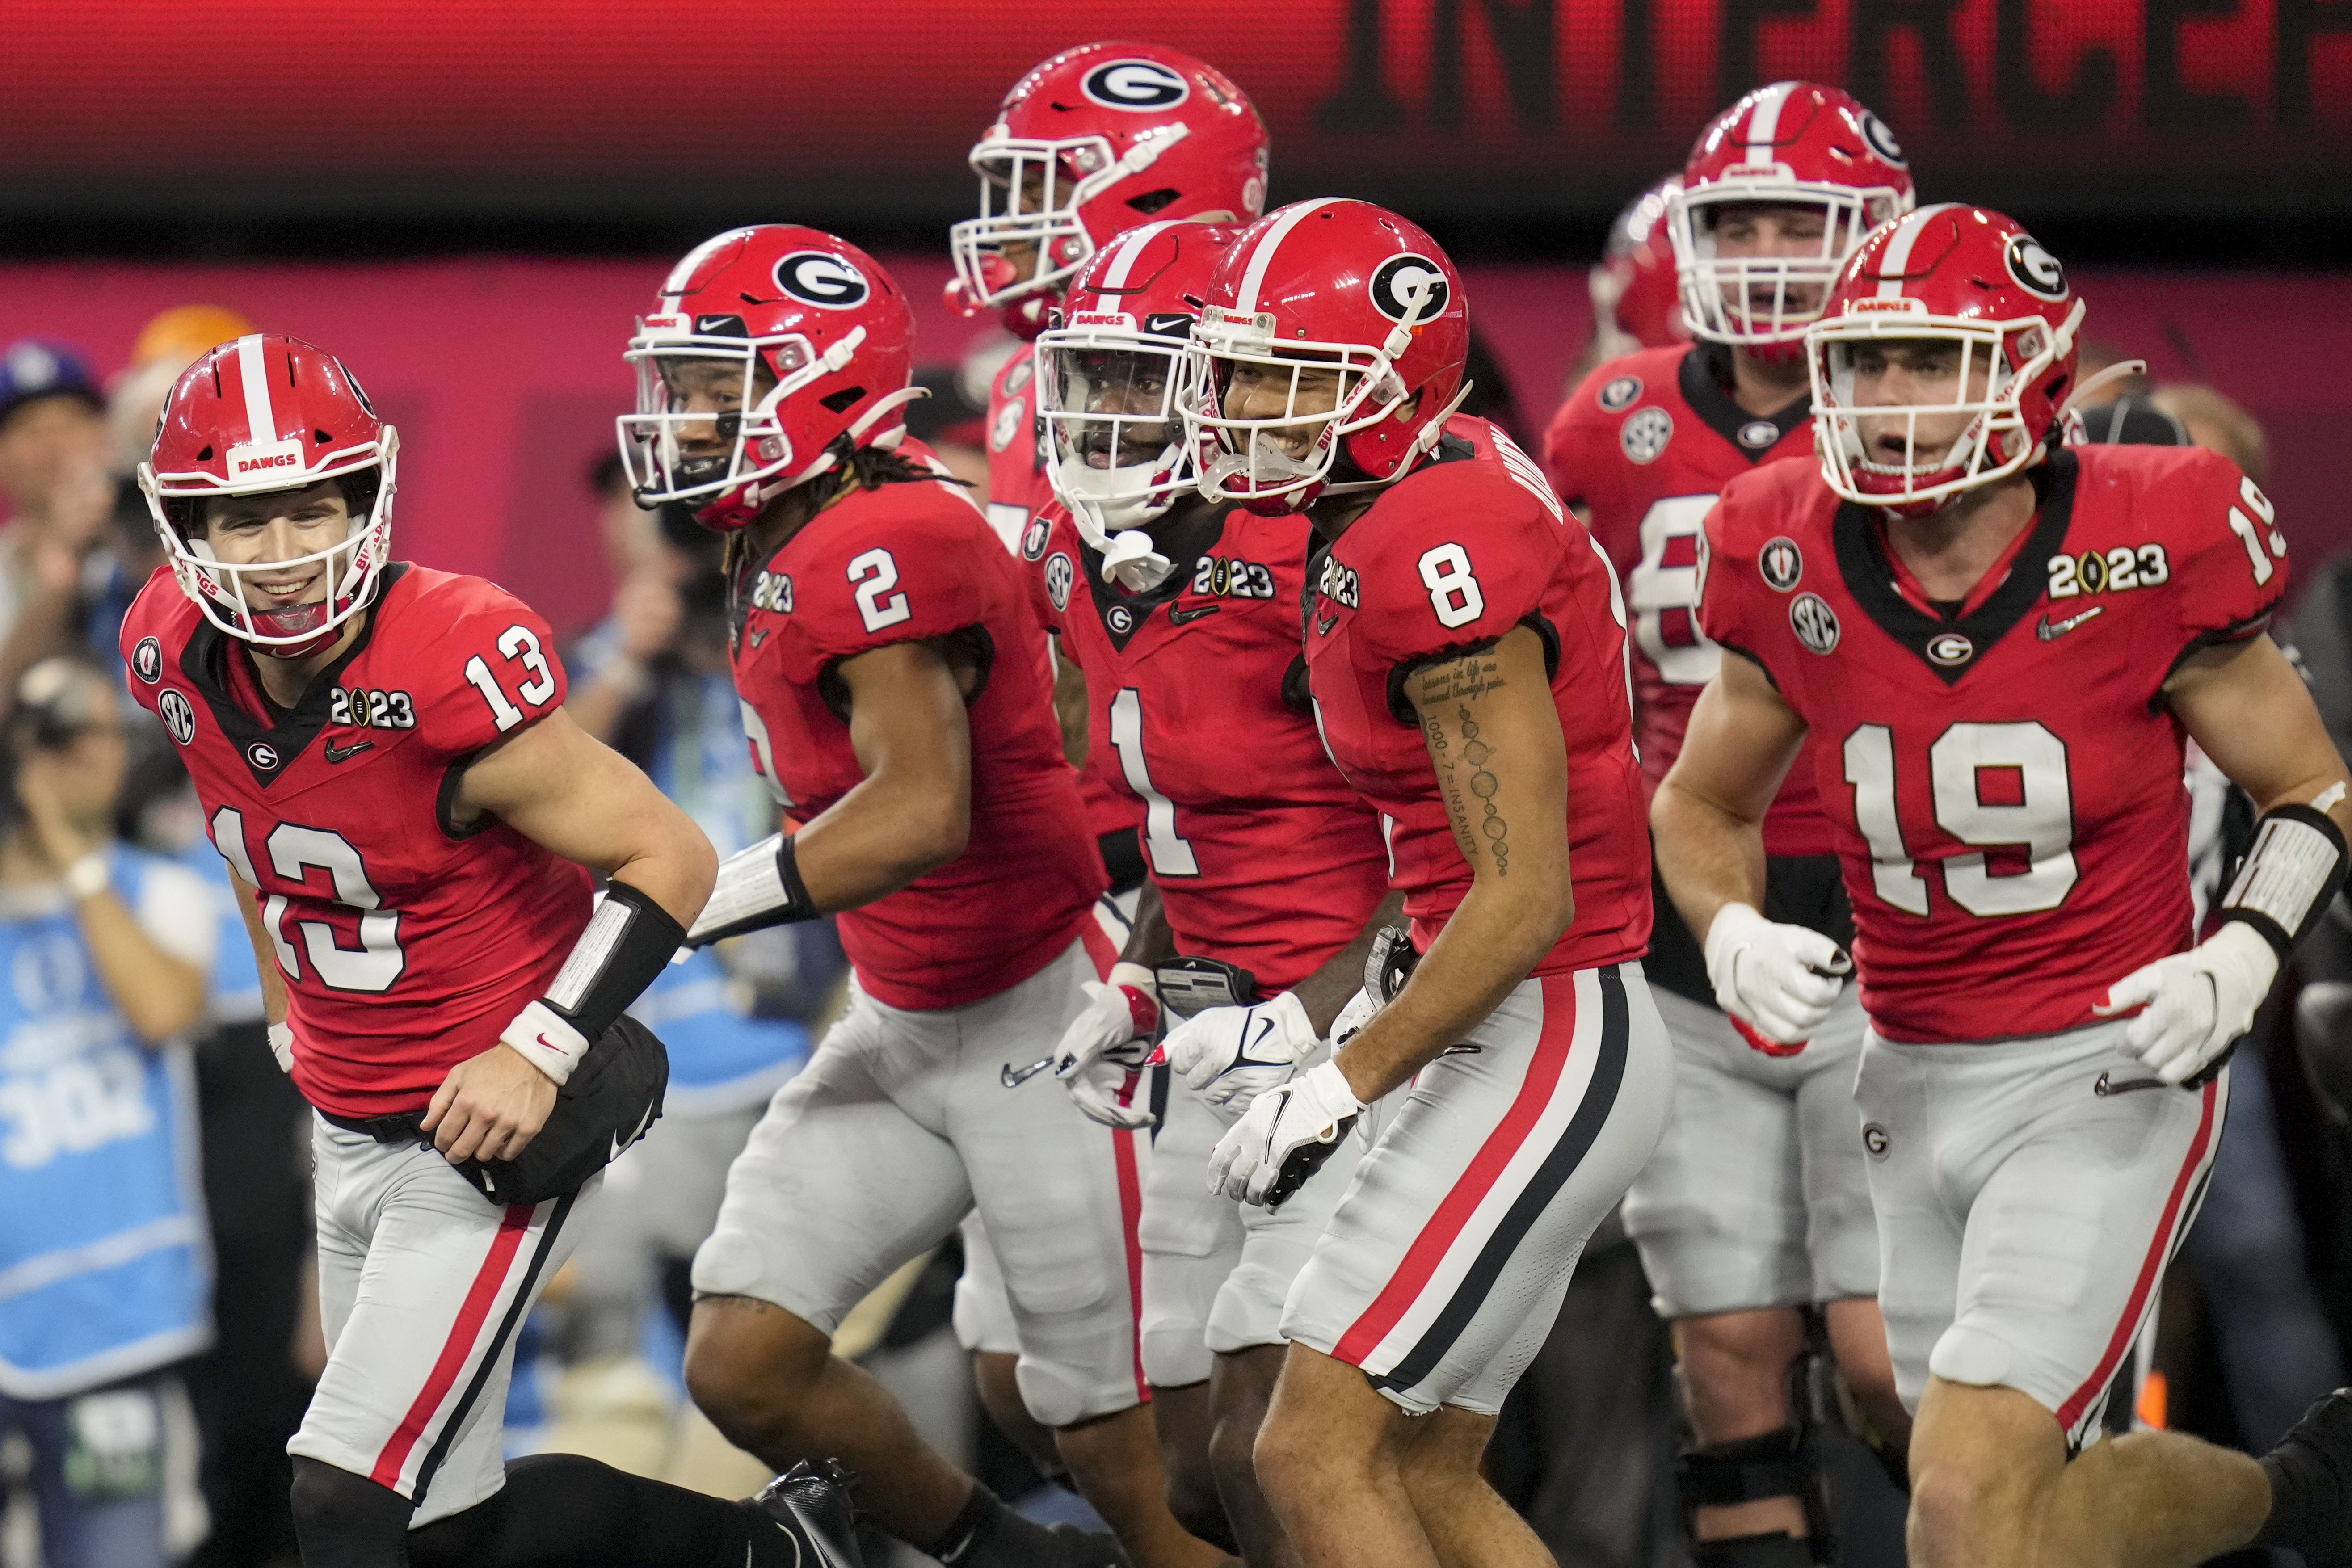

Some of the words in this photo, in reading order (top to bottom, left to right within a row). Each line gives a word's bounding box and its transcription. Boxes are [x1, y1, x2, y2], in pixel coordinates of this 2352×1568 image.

[1077, 314, 1125, 325] DAWGS
[238, 453, 296, 473] DAWGS
[2228, 475, 2287, 587] 19
[847, 547, 912, 633] 2
[1047, 558, 1070, 606] SEC
[1194, 555, 1274, 598] 2023
[1319, 554, 1359, 610] 2023
[1418, 542, 1485, 629] 8
[2047, 544, 2168, 597] 2023
[1794, 597, 1835, 648] SEC
[466, 626, 555, 732] 13
[161, 693, 192, 740] SEC
[331, 687, 416, 728] 2023
[1110, 687, 1202, 878] 1
[1449, 788, 1479, 855] INSANITY
[1842, 720, 2079, 917] 19
[211, 805, 405, 994] 13
